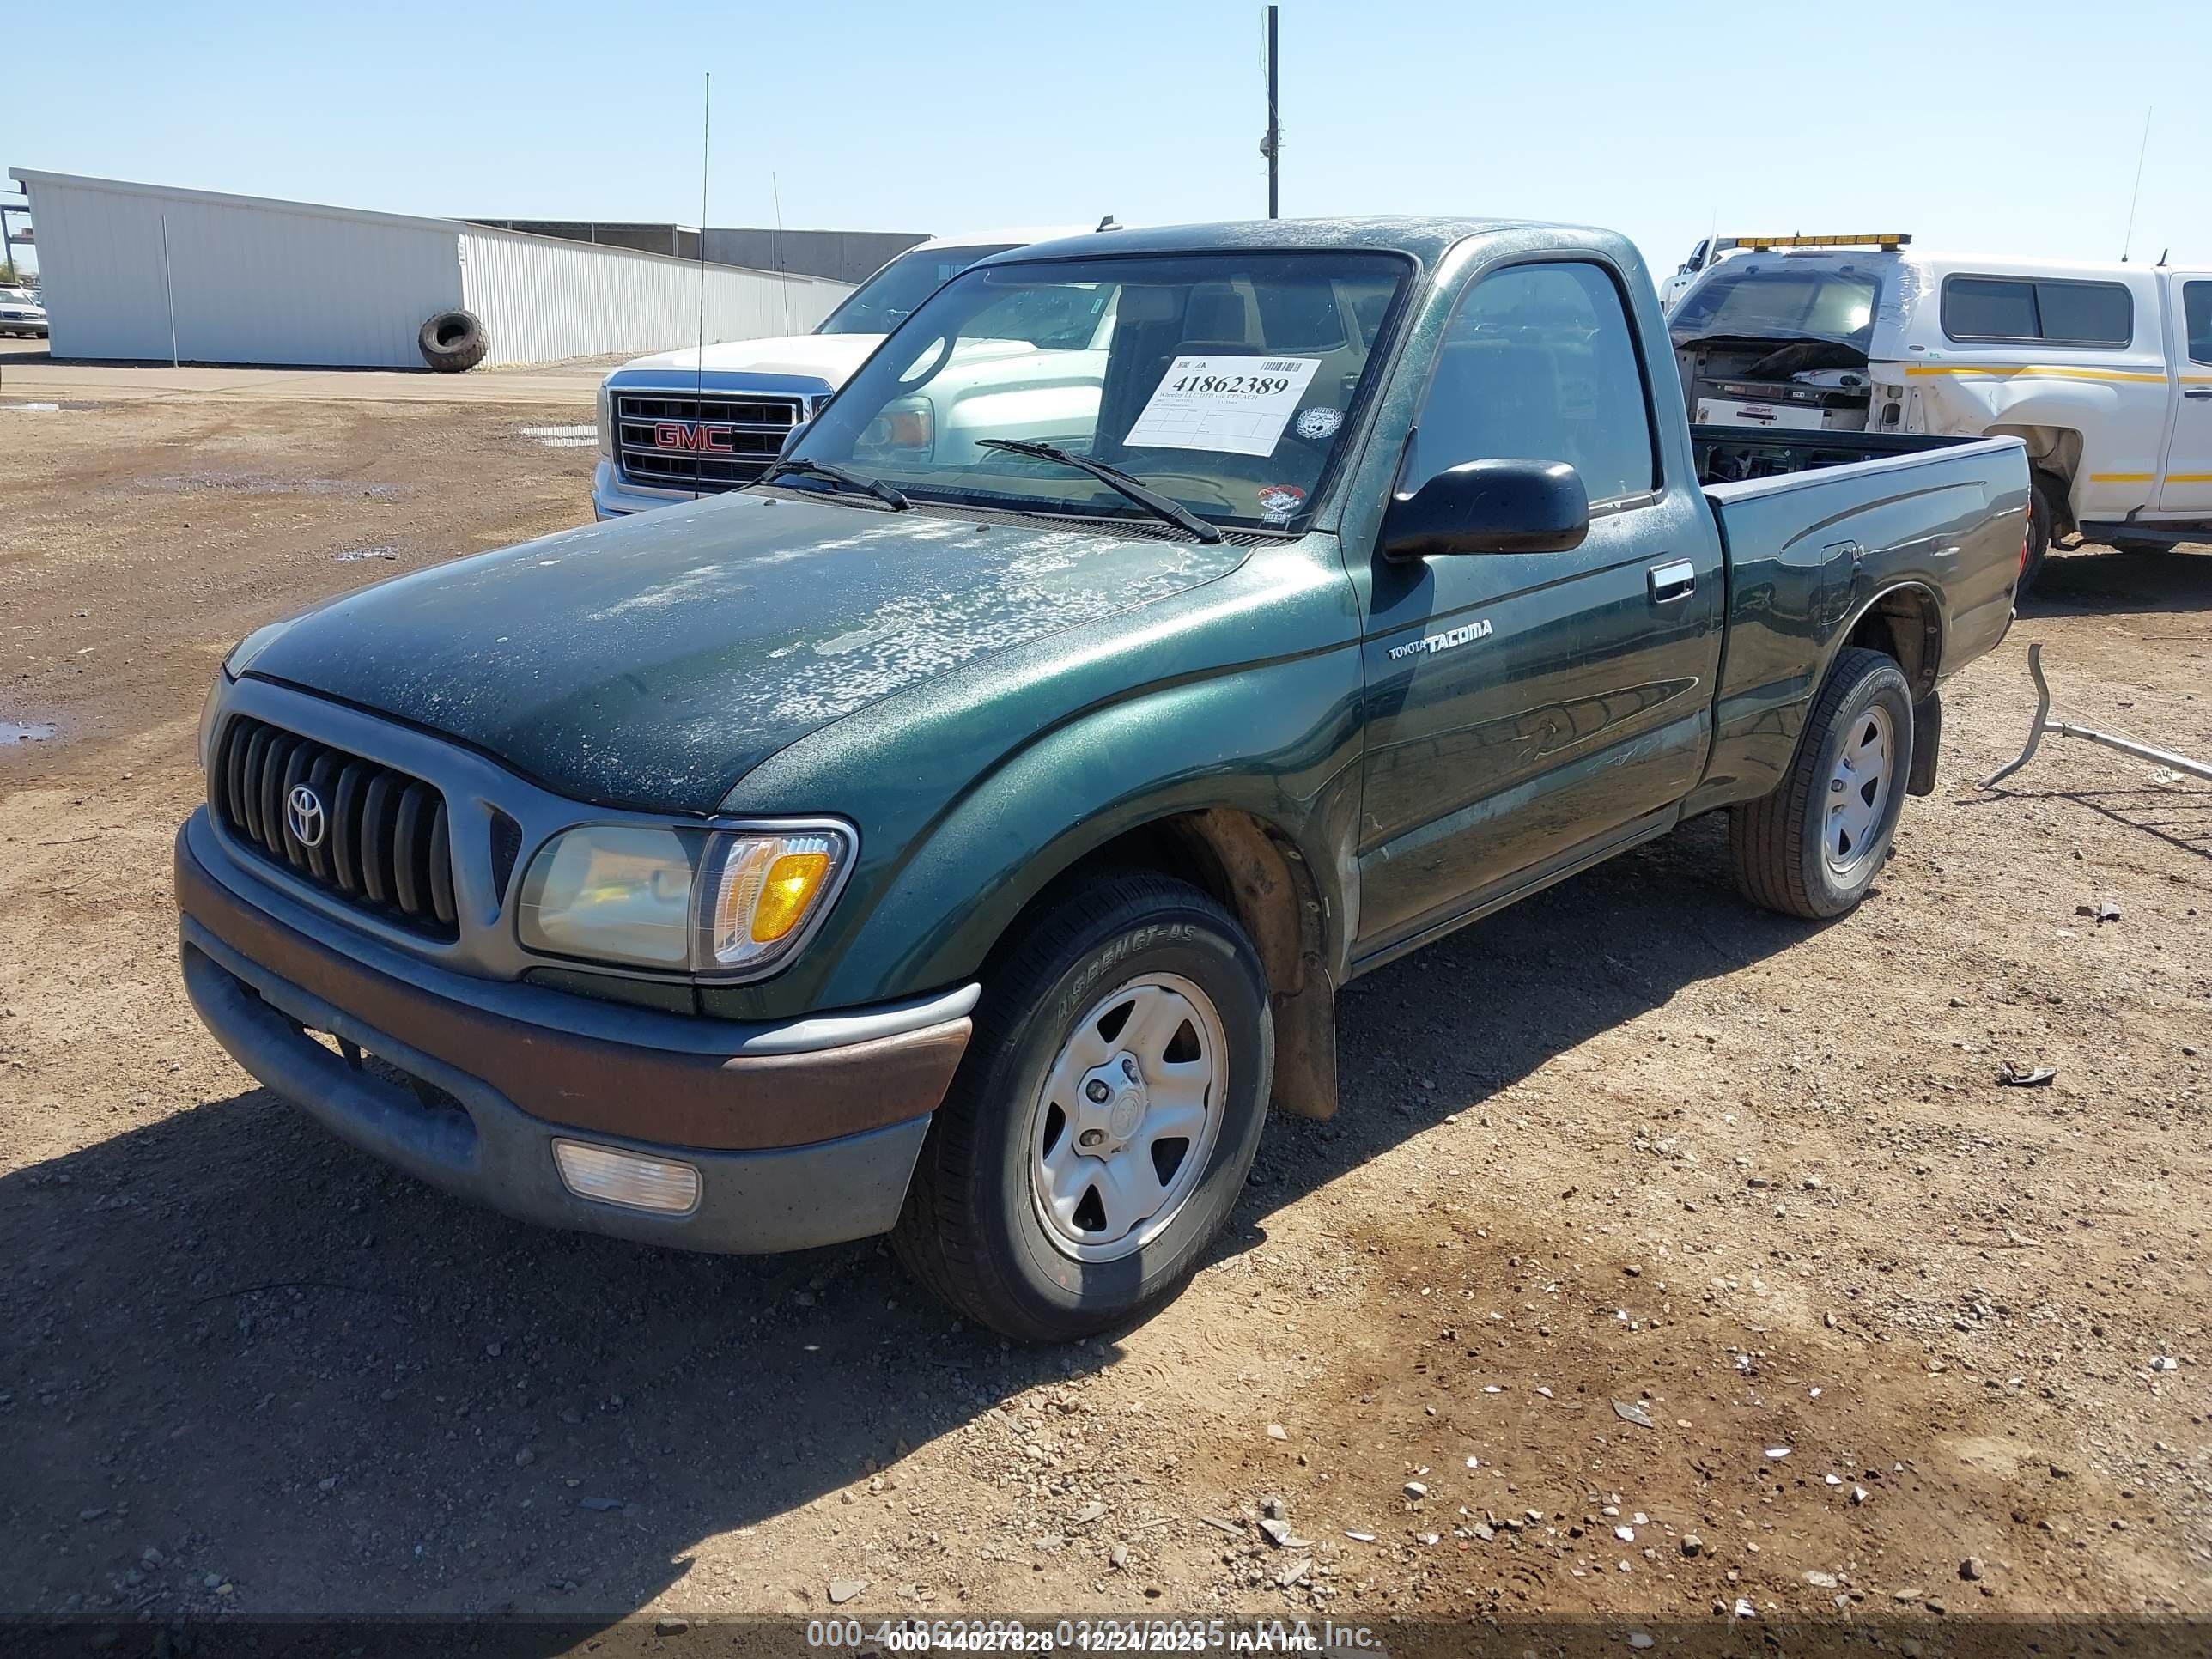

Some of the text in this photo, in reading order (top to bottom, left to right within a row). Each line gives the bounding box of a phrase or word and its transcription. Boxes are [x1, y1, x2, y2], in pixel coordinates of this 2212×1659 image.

[1173, 375, 1288, 395] 41862389
[655, 422, 735, 453] GMC
[1388, 619, 1493, 660] TOYOTA TACOMA
